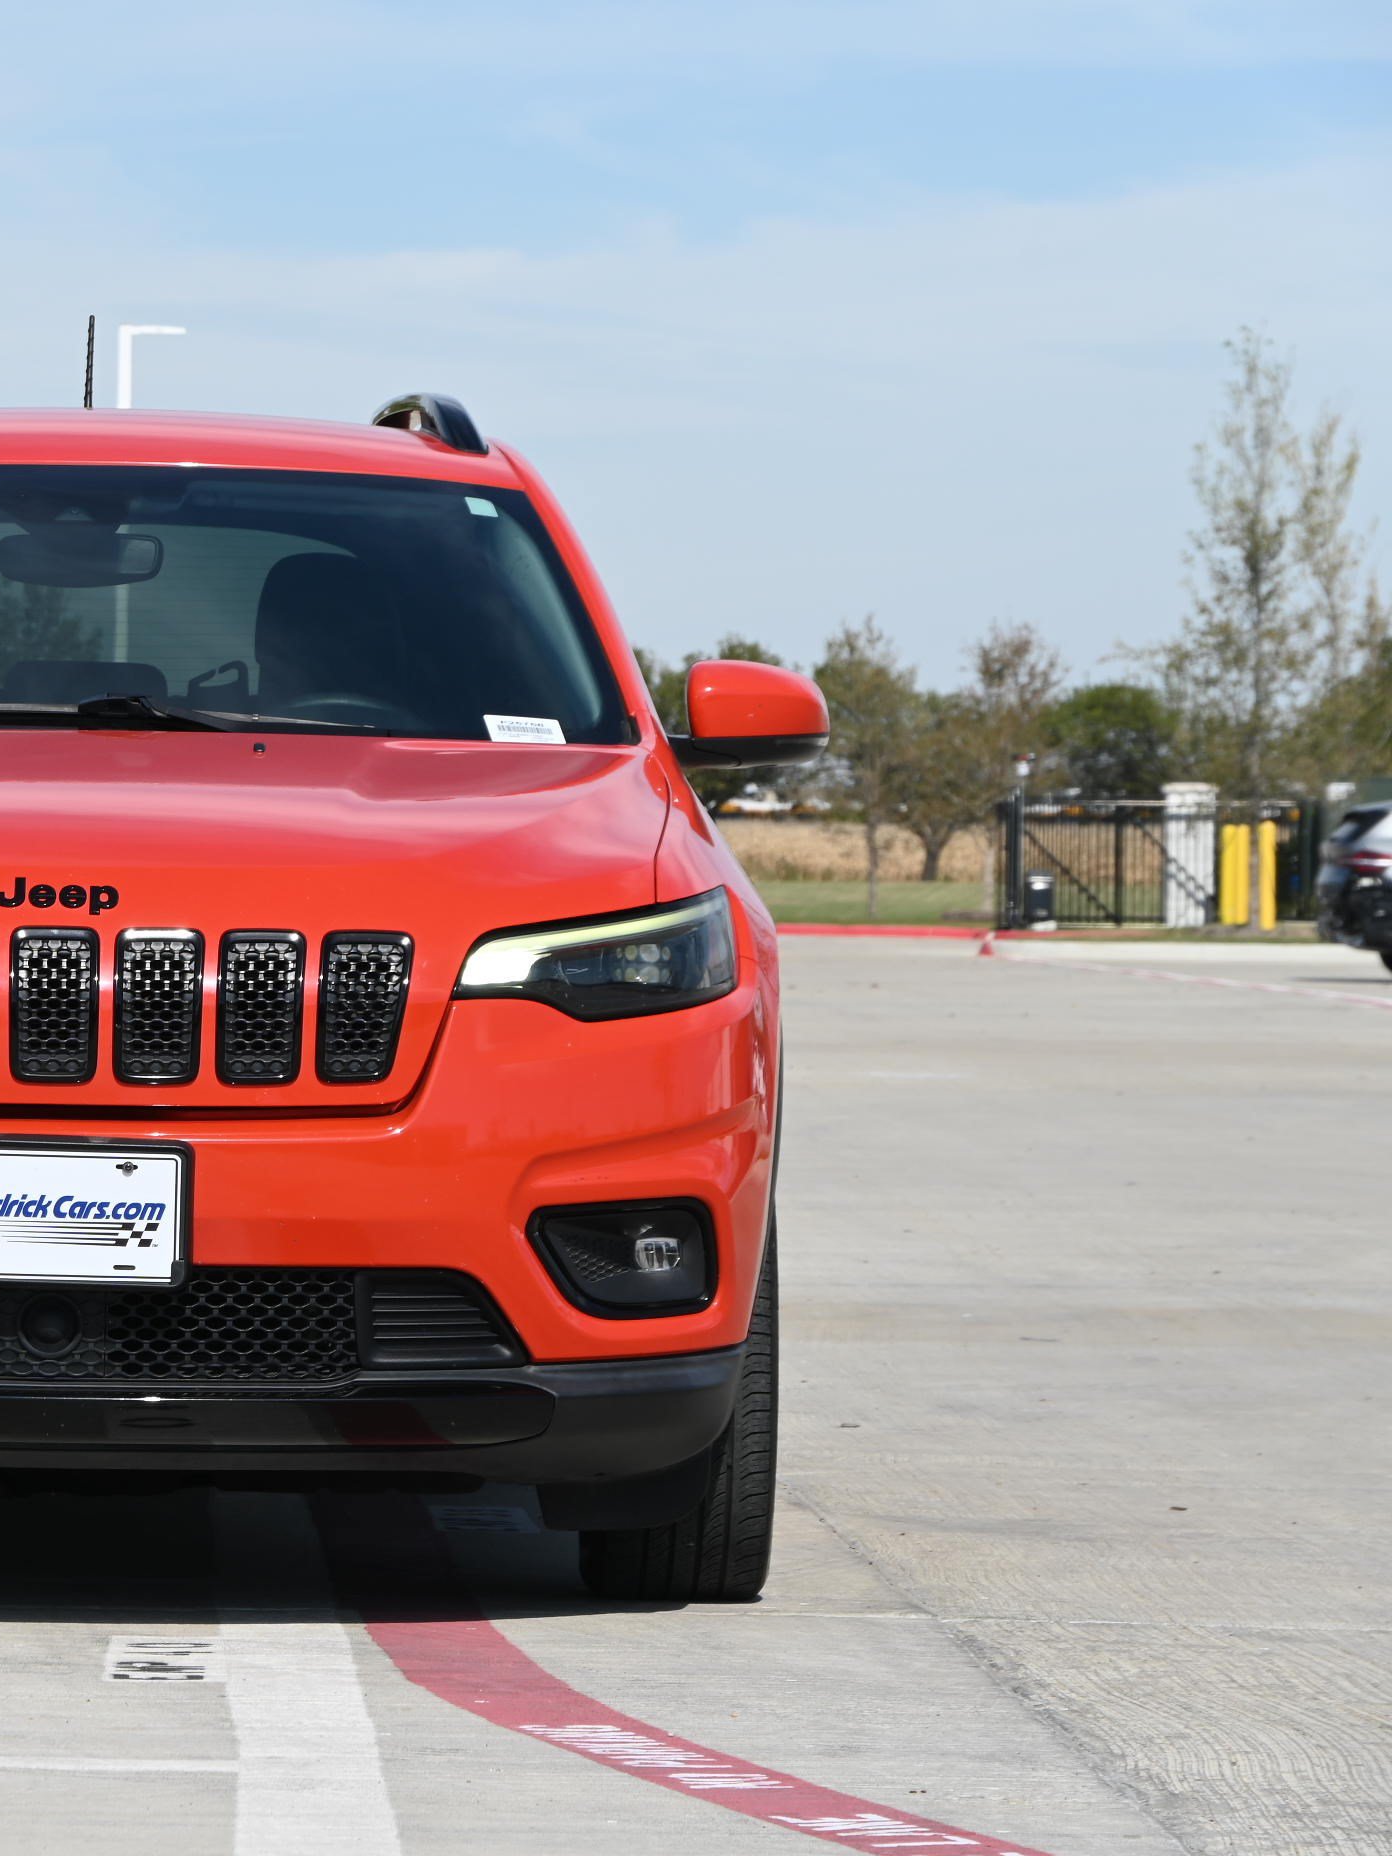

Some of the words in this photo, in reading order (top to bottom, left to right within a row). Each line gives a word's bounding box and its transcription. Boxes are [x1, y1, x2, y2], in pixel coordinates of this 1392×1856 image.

[518, 1724, 733, 1769] PARKING
[668, 1773, 794, 1789] NO
[768, 1813, 981, 1848] LANE
